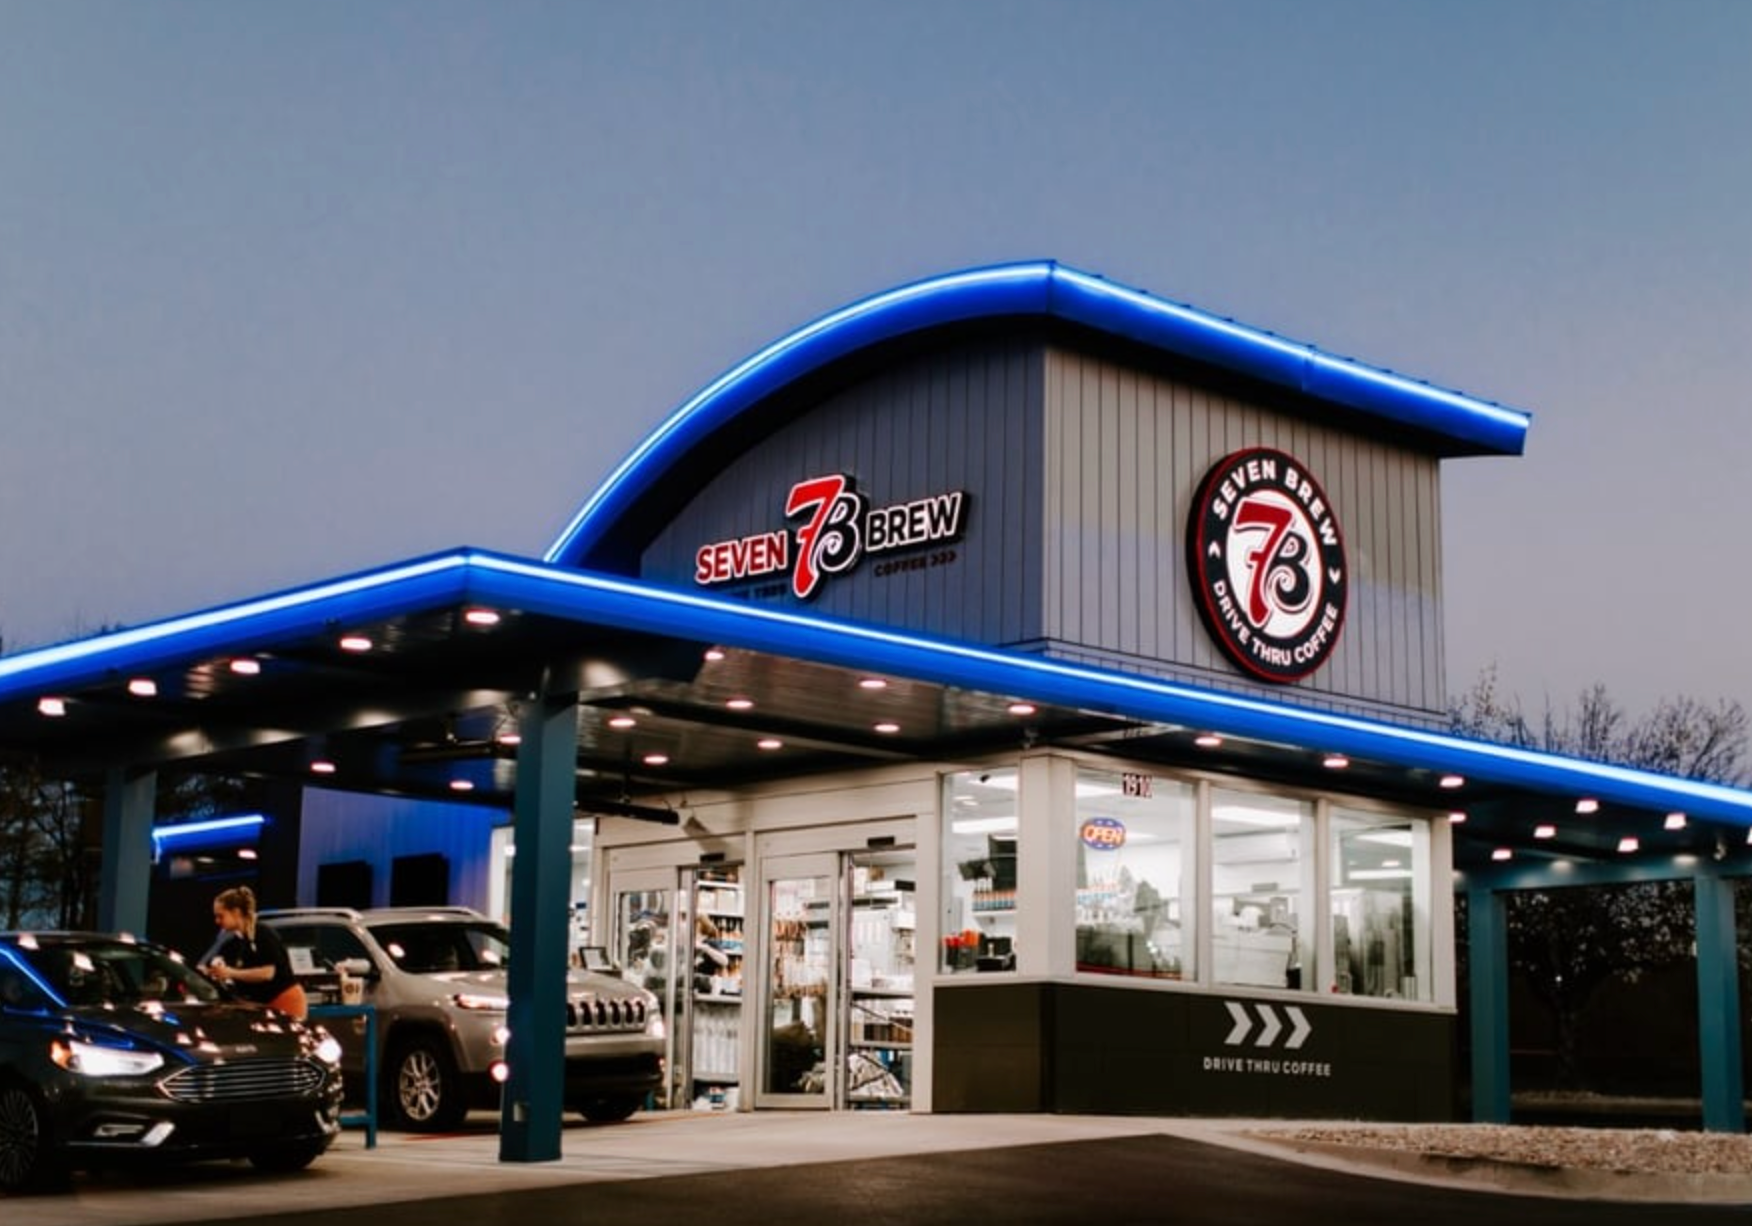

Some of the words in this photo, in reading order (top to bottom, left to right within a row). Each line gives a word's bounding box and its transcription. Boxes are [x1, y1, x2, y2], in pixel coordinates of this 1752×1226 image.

[695, 530, 788, 584] SEVEN
[865, 492, 963, 551] BREW
[1213, 460, 1276, 520] SEVEN
[1284, 468, 1337, 546] BREW
[1213, 580, 1251, 645] DRIVE
[1251, 637, 1292, 666] THRU
[1294, 603, 1339, 664] COFFEE
[1082, 824, 1122, 845] OPEN
[1203, 1056, 1243, 1072] DRIVE
[1246, 1059, 1280, 1073] THRU
[1282, 1061, 1331, 1076] COFFEE
